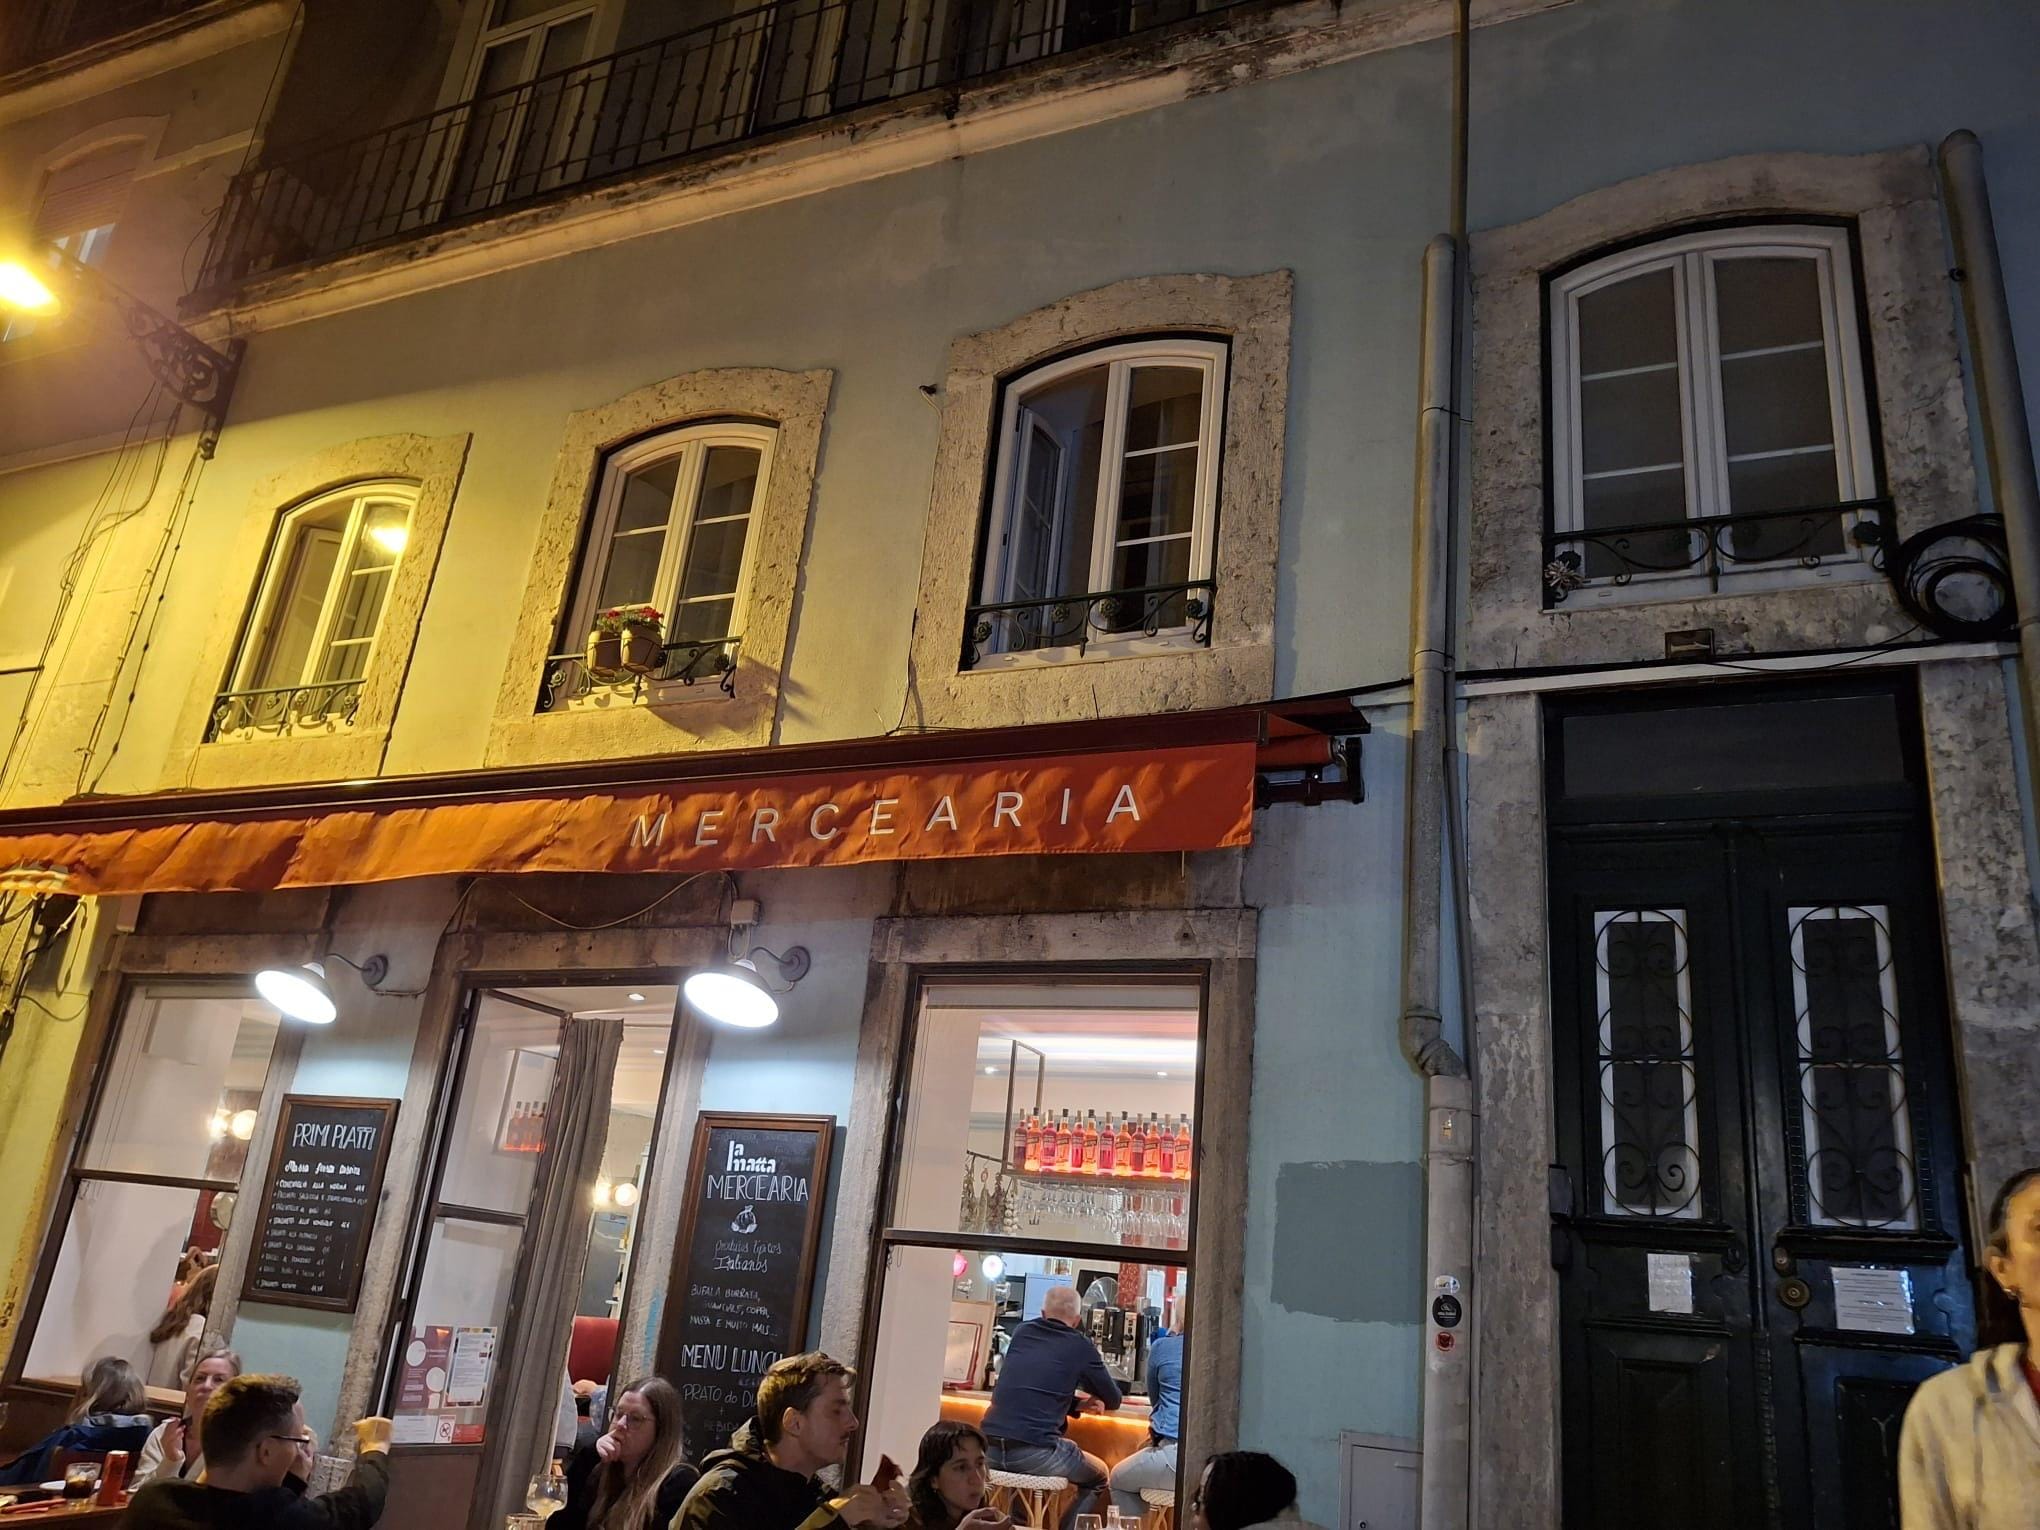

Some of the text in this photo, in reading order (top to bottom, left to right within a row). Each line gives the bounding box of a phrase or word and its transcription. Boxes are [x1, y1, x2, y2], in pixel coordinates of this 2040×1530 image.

[630, 784, 1142, 848] MERCEARIA
[292, 1123, 376, 1150] PRIMI PIATTI
[706, 1174, 809, 1202] MERCEARIA
[681, 1344, 727, 1370] MENU
[682, 1384, 722, 1401] PRATO
[724, 1391, 738, 1404] do
